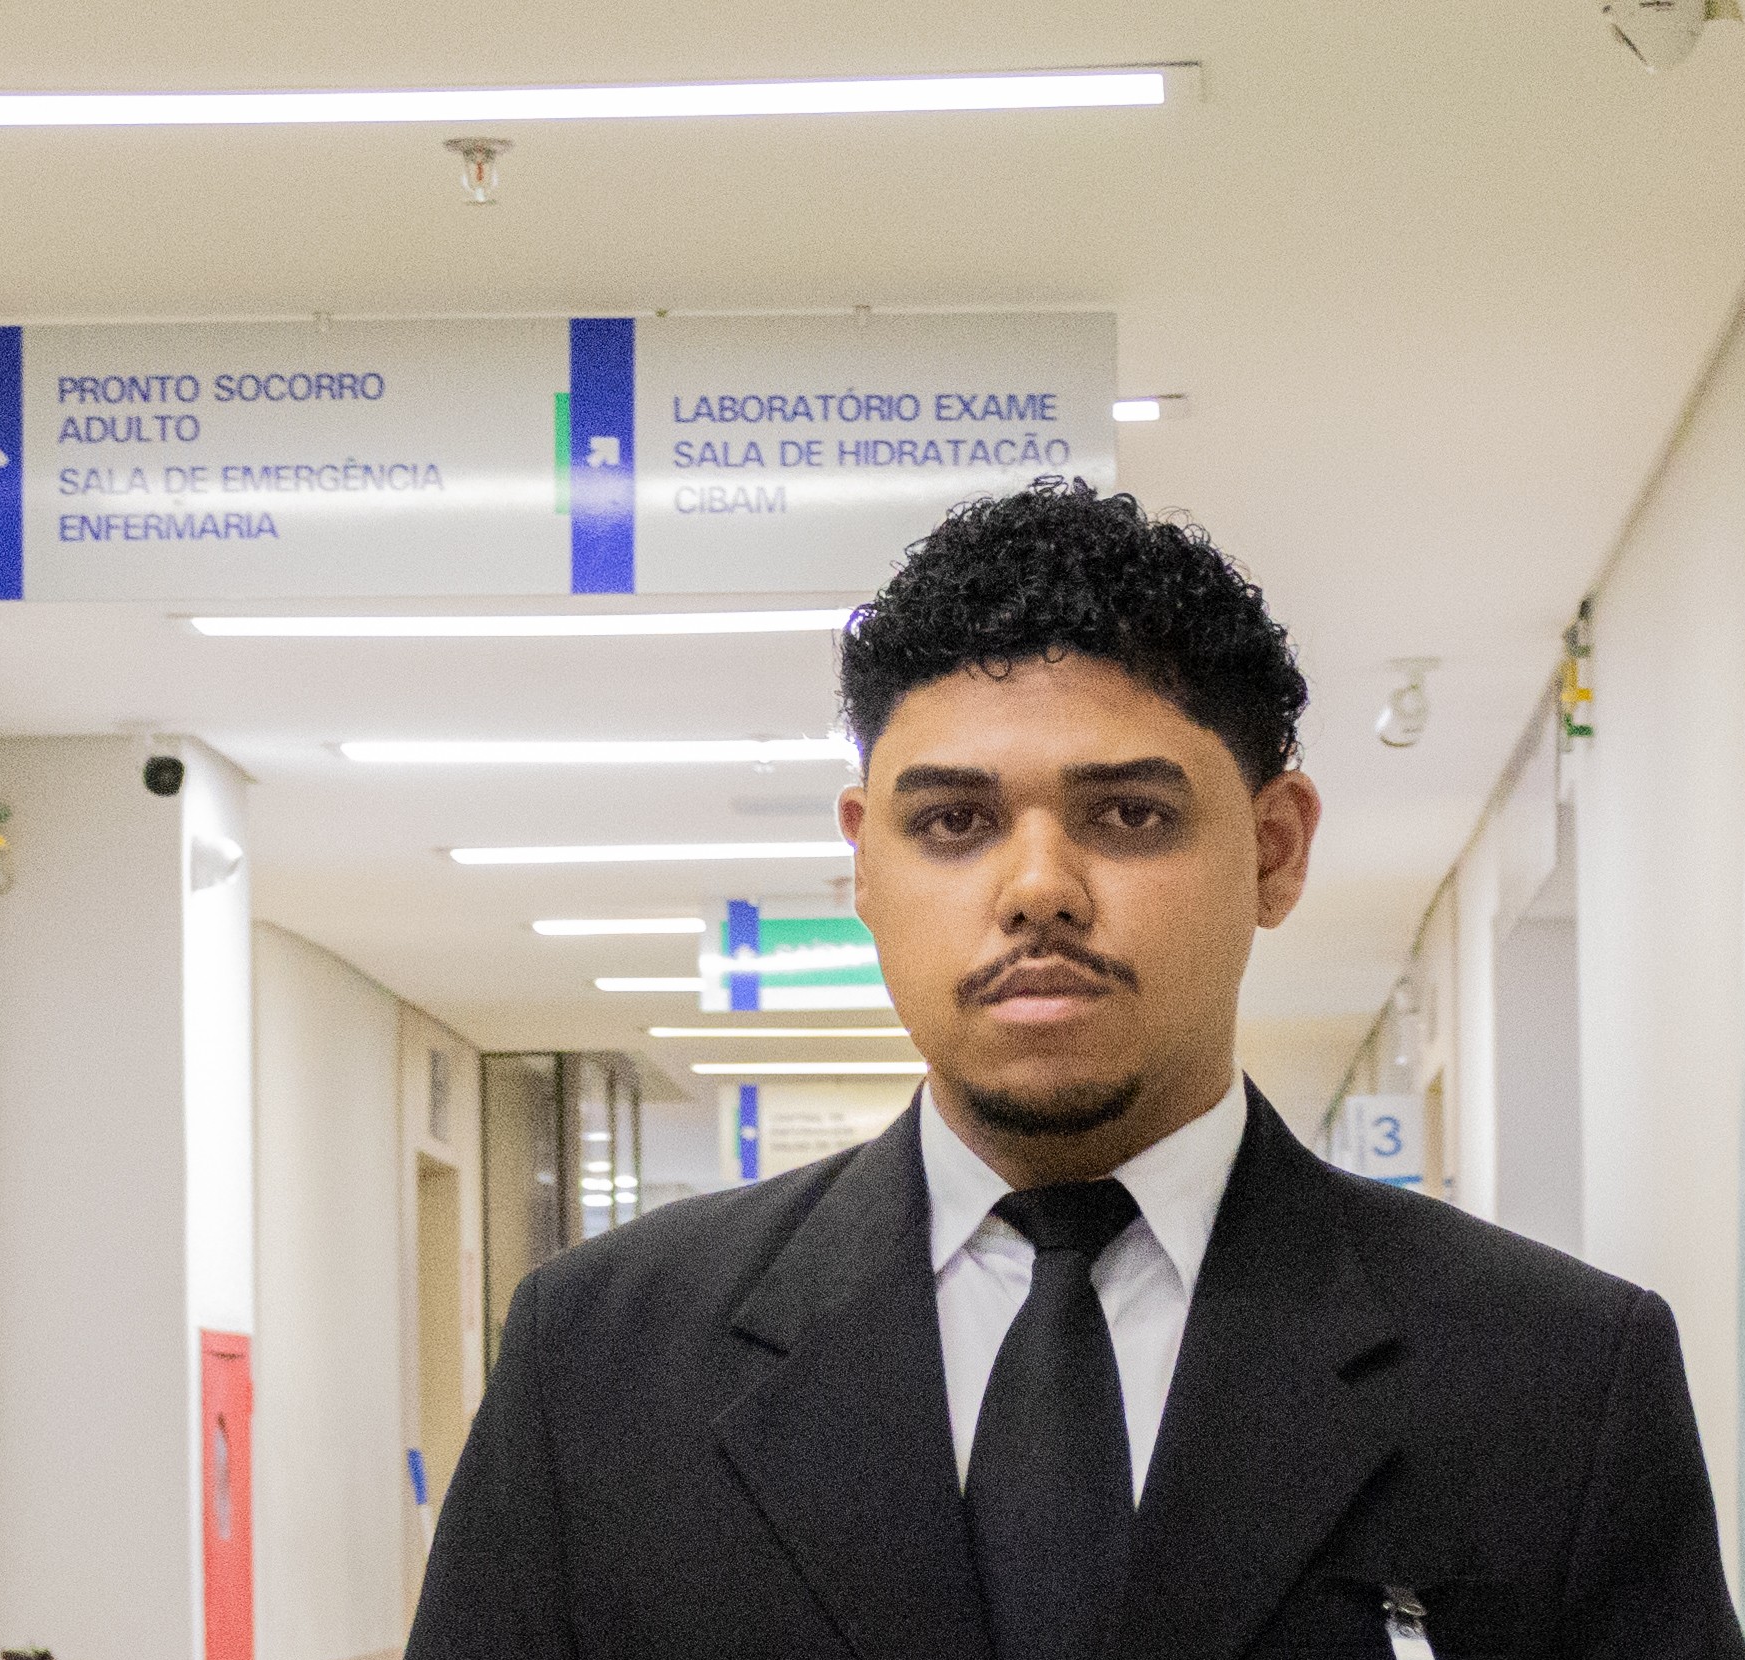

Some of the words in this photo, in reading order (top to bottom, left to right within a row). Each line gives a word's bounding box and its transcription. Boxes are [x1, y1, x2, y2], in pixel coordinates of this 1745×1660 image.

[57, 375, 200, 404] PRONTO
[213, 372, 386, 402] SOCORRO
[673, 388, 921, 423] LABORATÓRIO
[934, 393, 1058, 423] EXAME
[58, 414, 201, 444] ADULTO
[673, 440, 766, 468] SALA
[779, 439, 824, 467] DE
[837, 433, 1071, 472] HIDRATAÇÃO
[58, 466, 150, 496] SALA
[164, 465, 208, 494] DE
[220, 458, 446, 494] EMERGÊNCIA
[673, 484, 788, 514] CIBAM
[59, 512, 280, 542] ENFERMARIA
[1372, 1115, 1404, 1157] 3
